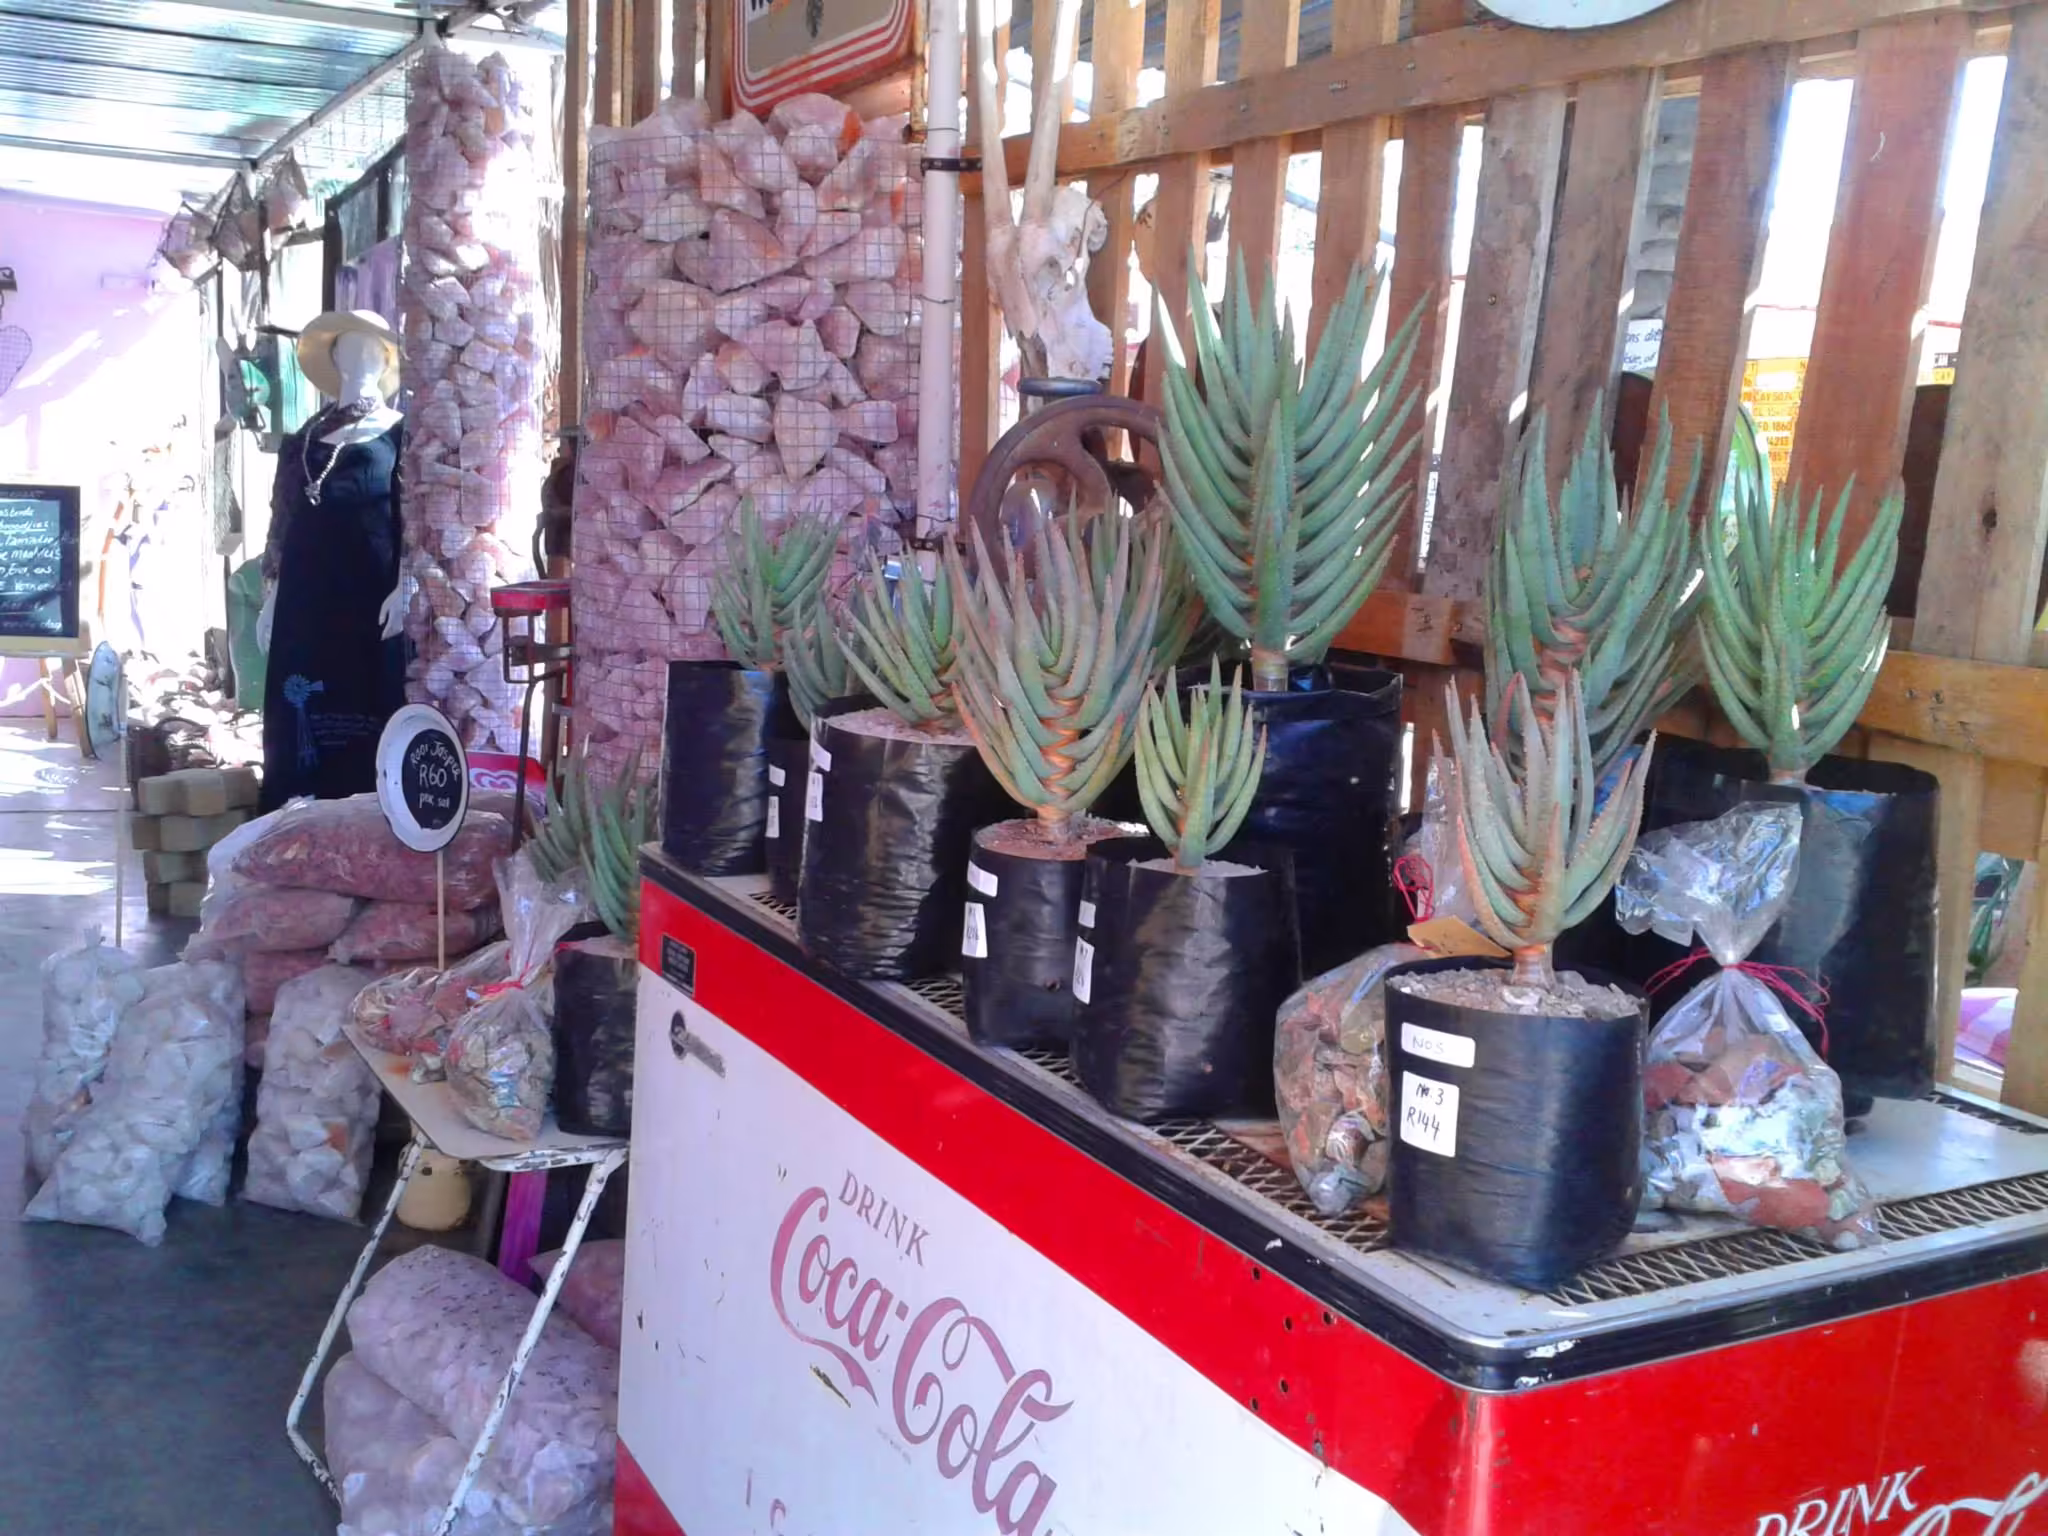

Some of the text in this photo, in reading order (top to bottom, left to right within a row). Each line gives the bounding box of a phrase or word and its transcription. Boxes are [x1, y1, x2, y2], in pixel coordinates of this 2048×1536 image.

[419, 763, 448, 788] R60
[1407, 1106, 1440, 1141] R144
[838, 1170, 931, 1267] DRINK
[1756, 1465, 1926, 1536] DRINK
